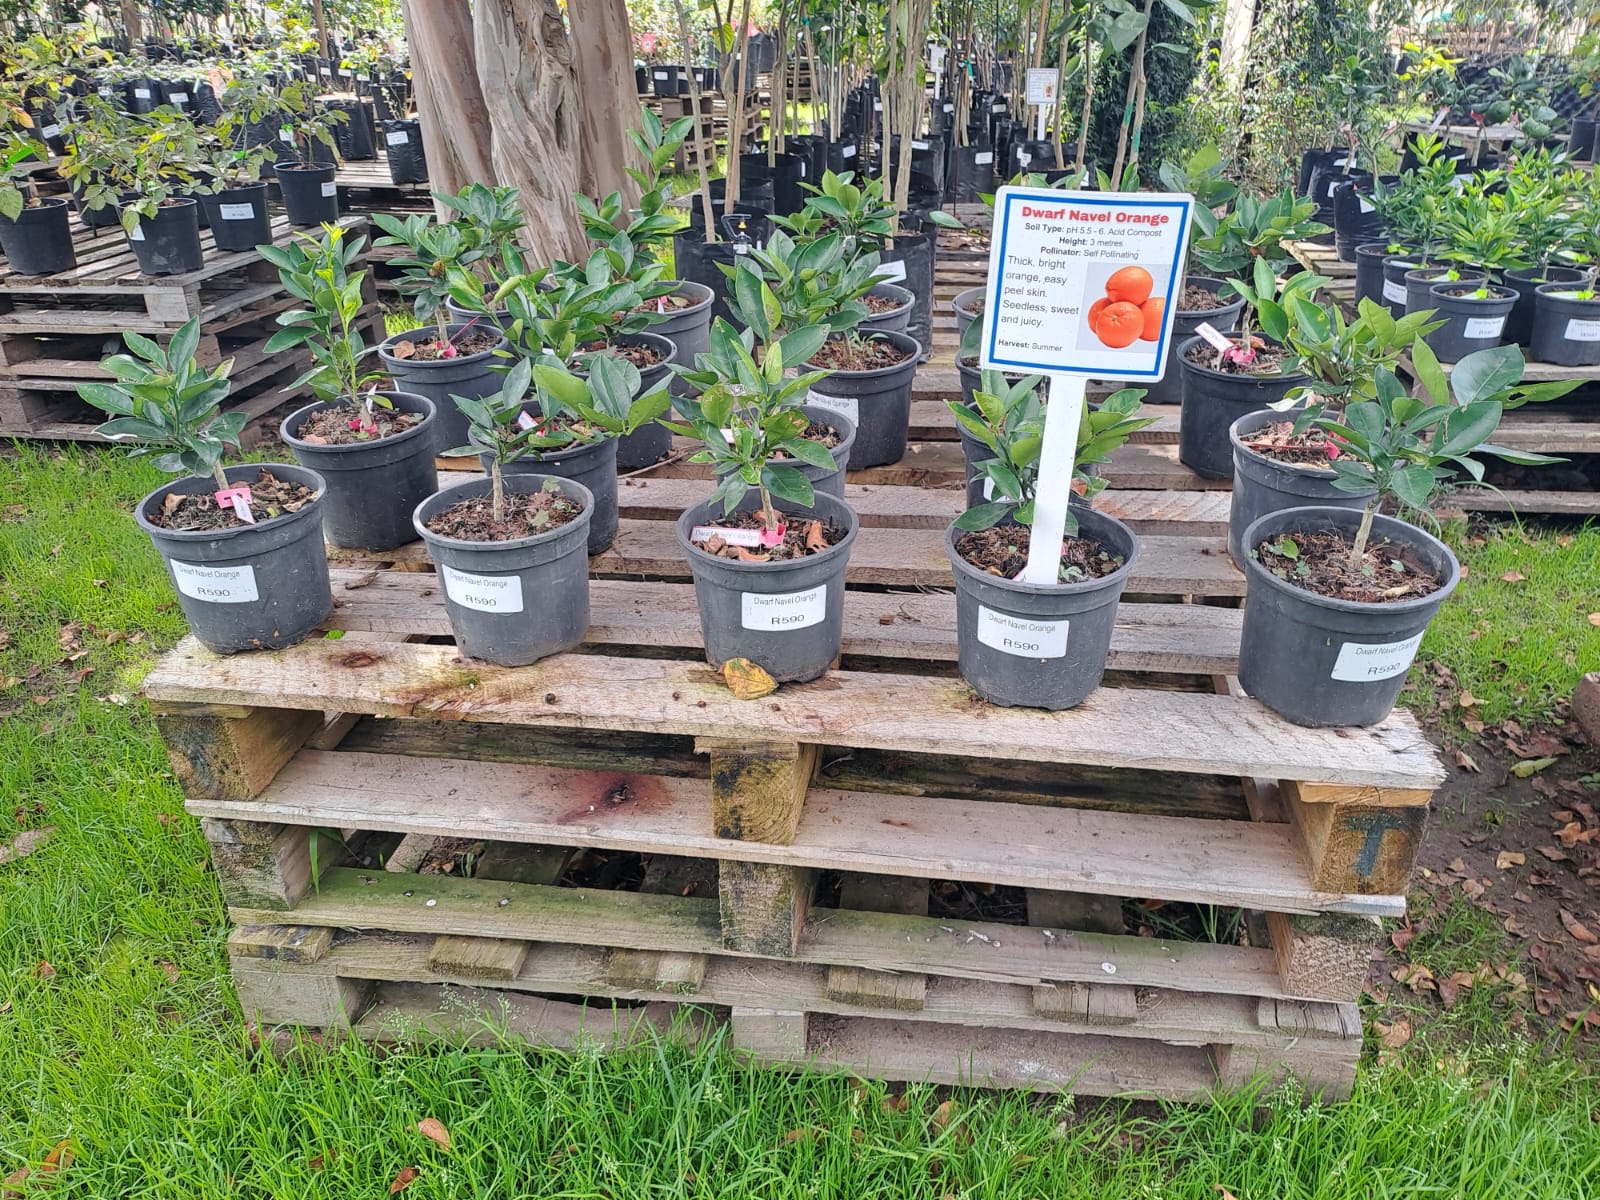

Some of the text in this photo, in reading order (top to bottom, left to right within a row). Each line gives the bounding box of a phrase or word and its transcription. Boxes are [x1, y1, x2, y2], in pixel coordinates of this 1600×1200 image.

[1022, 206, 1169, 226] Dwarf Navel Orange
[1025, 222, 1041, 231] Soil
[1042, 223, 1065, 233] Type:
[1066, 226, 1078, 234] pH
[1108, 227, 1125, 236] Acid
[1127, 228, 1162, 238] Compost
[1059, 236, 1123, 247] Height: 3 metres
[1040, 246, 1139, 260] Pollinator: Self Pollinating
[1007, 255, 1066, 270] Thick, bright
[1005, 272, 1067, 286] orange, easy
[1004, 286, 1047, 297] peel skin.
[1002, 299, 1079, 315] Seedless, sweet
[1001, 315, 1044, 328] and juicy.
[998, 339, 1064, 351] Harvest: Summer
[195, 569, 213, 578] Navel
[214, 570, 240, 580] Orange
[465, 575, 482, 586] Navel
[483, 579, 508, 589] Orange
[197, 586, 230, 597] R590
[465, 594, 497, 607] R590
[753, 596, 774, 606] Dwarf
[774, 597, 794, 606] Navel
[771, 614, 805, 625] R590
[988, 613, 1056, 633] Dwarf Navel Orange
[1003, 637, 1040, 651] R590
[1355, 647, 1378, 656] Dwarf
[1378, 646, 1397, 655] Navel
[1367, 662, 1401, 676] R590
